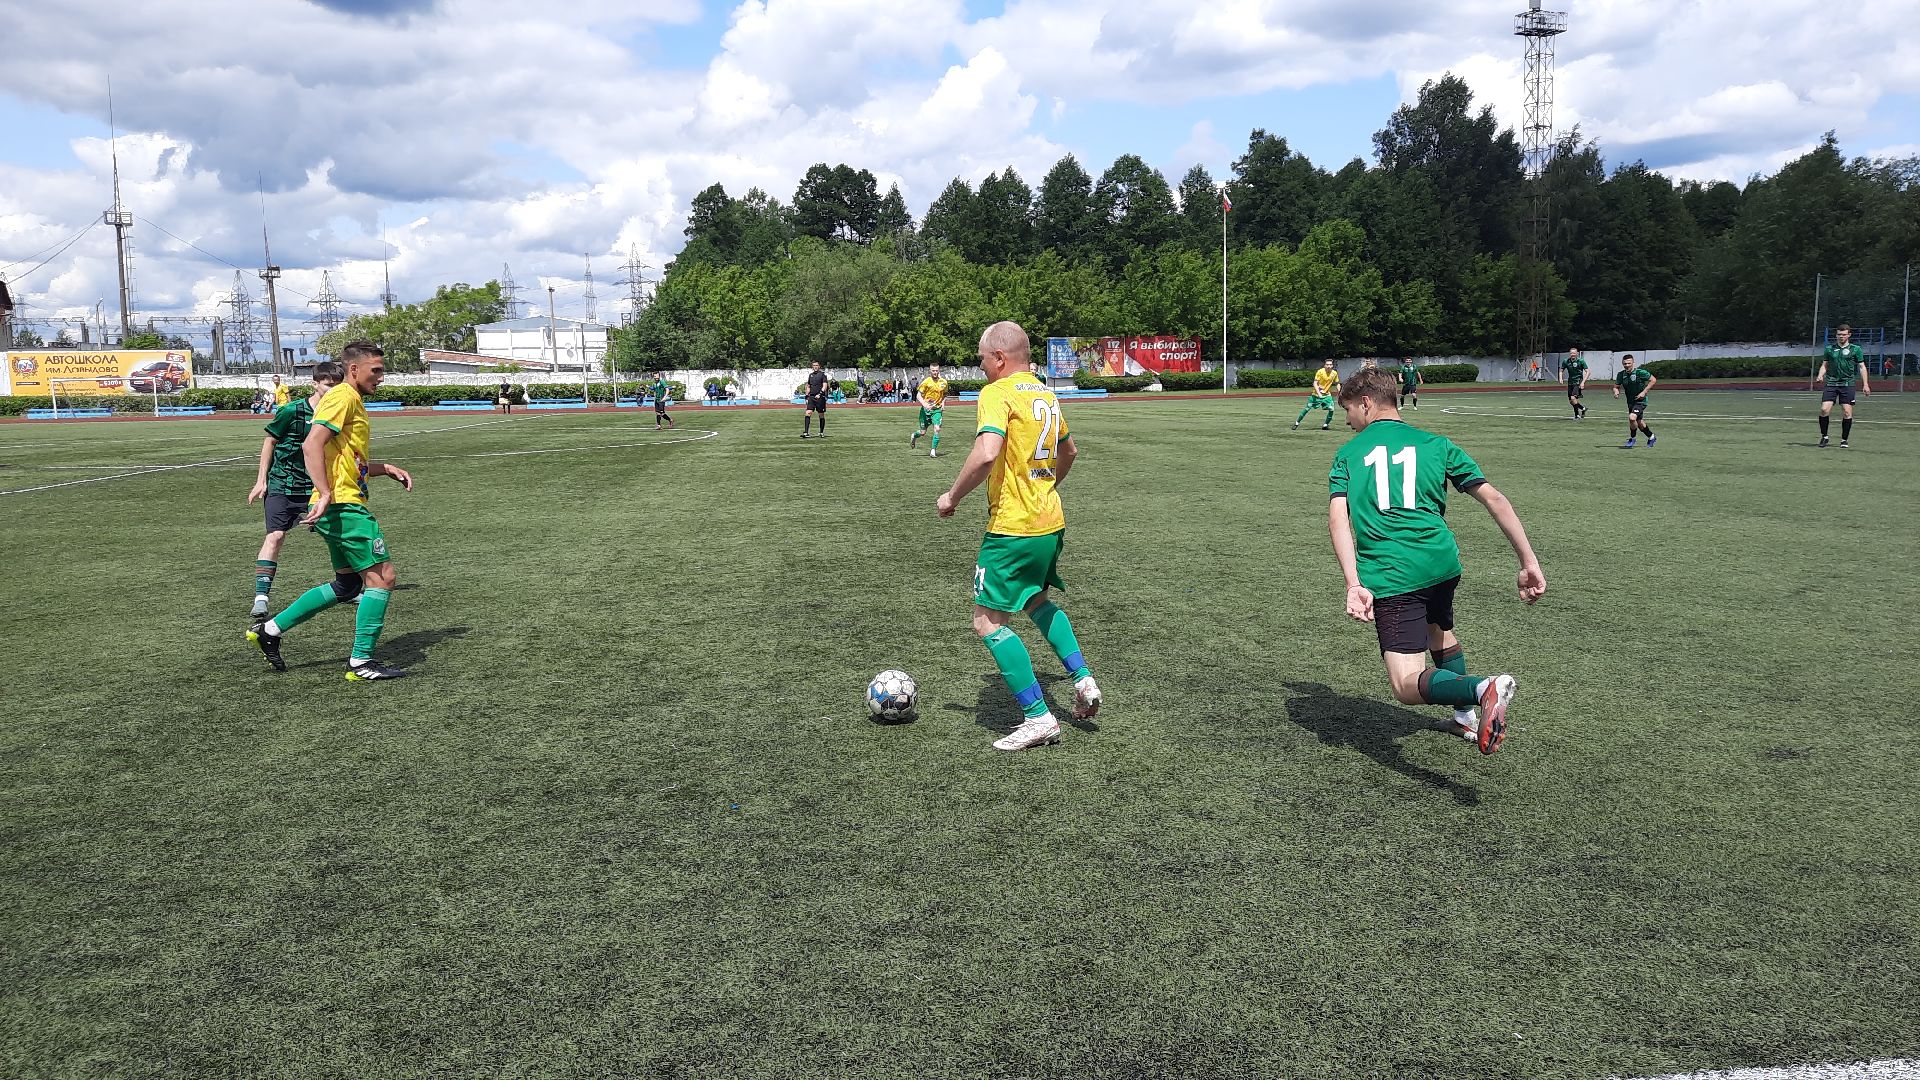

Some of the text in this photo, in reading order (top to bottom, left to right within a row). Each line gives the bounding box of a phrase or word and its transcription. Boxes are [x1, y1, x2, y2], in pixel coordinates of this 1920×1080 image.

[1107, 340, 1120, 349] 112
[1129, 340, 1197, 351] Я выбираю
[45, 355, 118, 364] АВТОШКОЛА
[1159, 350, 1197, 361] спорт!
[1033, 399, 1060, 460] 21
[1364, 446, 1417, 511] 11
